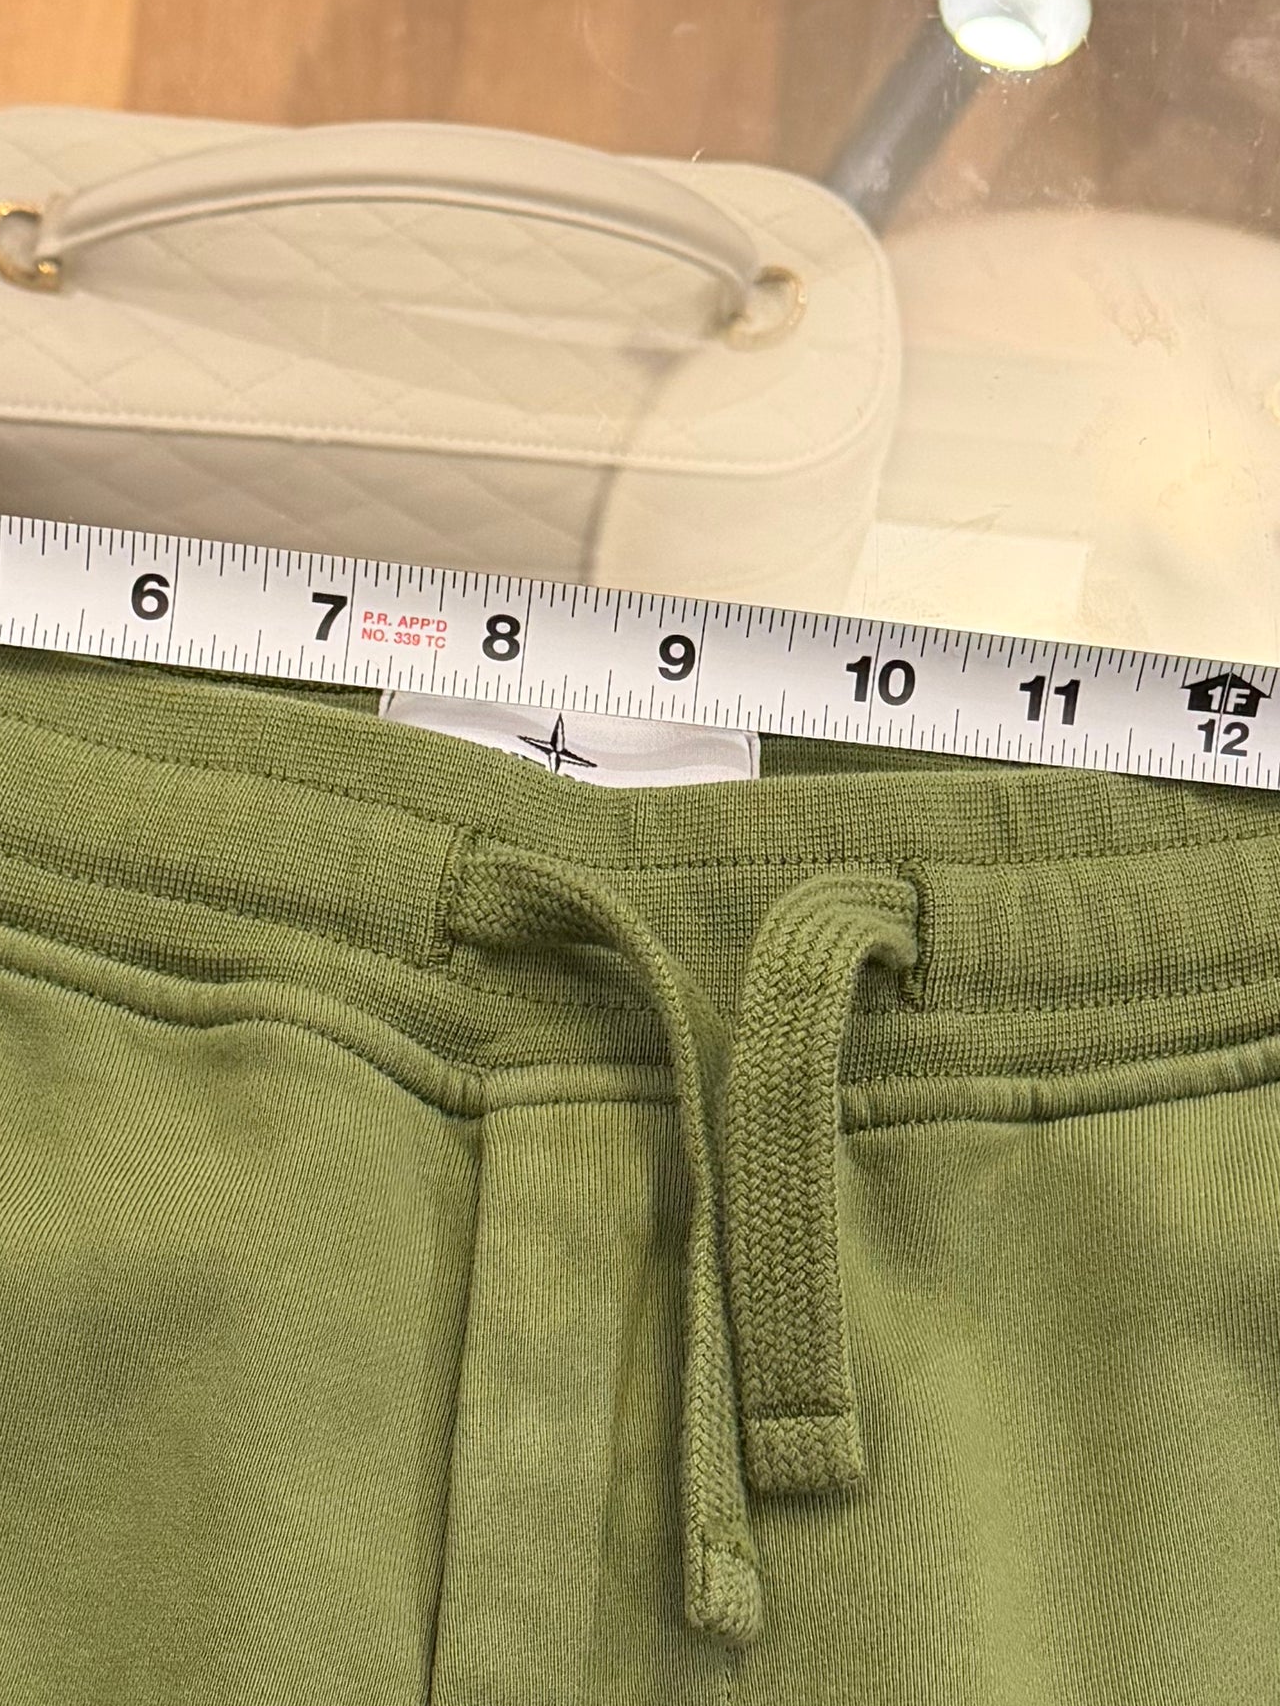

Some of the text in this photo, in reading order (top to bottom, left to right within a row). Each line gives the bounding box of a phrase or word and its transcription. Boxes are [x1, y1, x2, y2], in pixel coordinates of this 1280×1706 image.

[130, 574, 170, 621] 6
[310, 592, 348, 641] 7
[363, 611, 393, 627] P.R.
[361, 628, 447, 649] NO. 339 TC
[481, 614, 521, 662] 8
[657, 634, 696, 681] 9
[846, 655, 916, 707] 10
[1020, 676, 1083, 726] 11
[1207, 686, 1252, 713] 1F
[1197, 718, 1250, 757] 12
